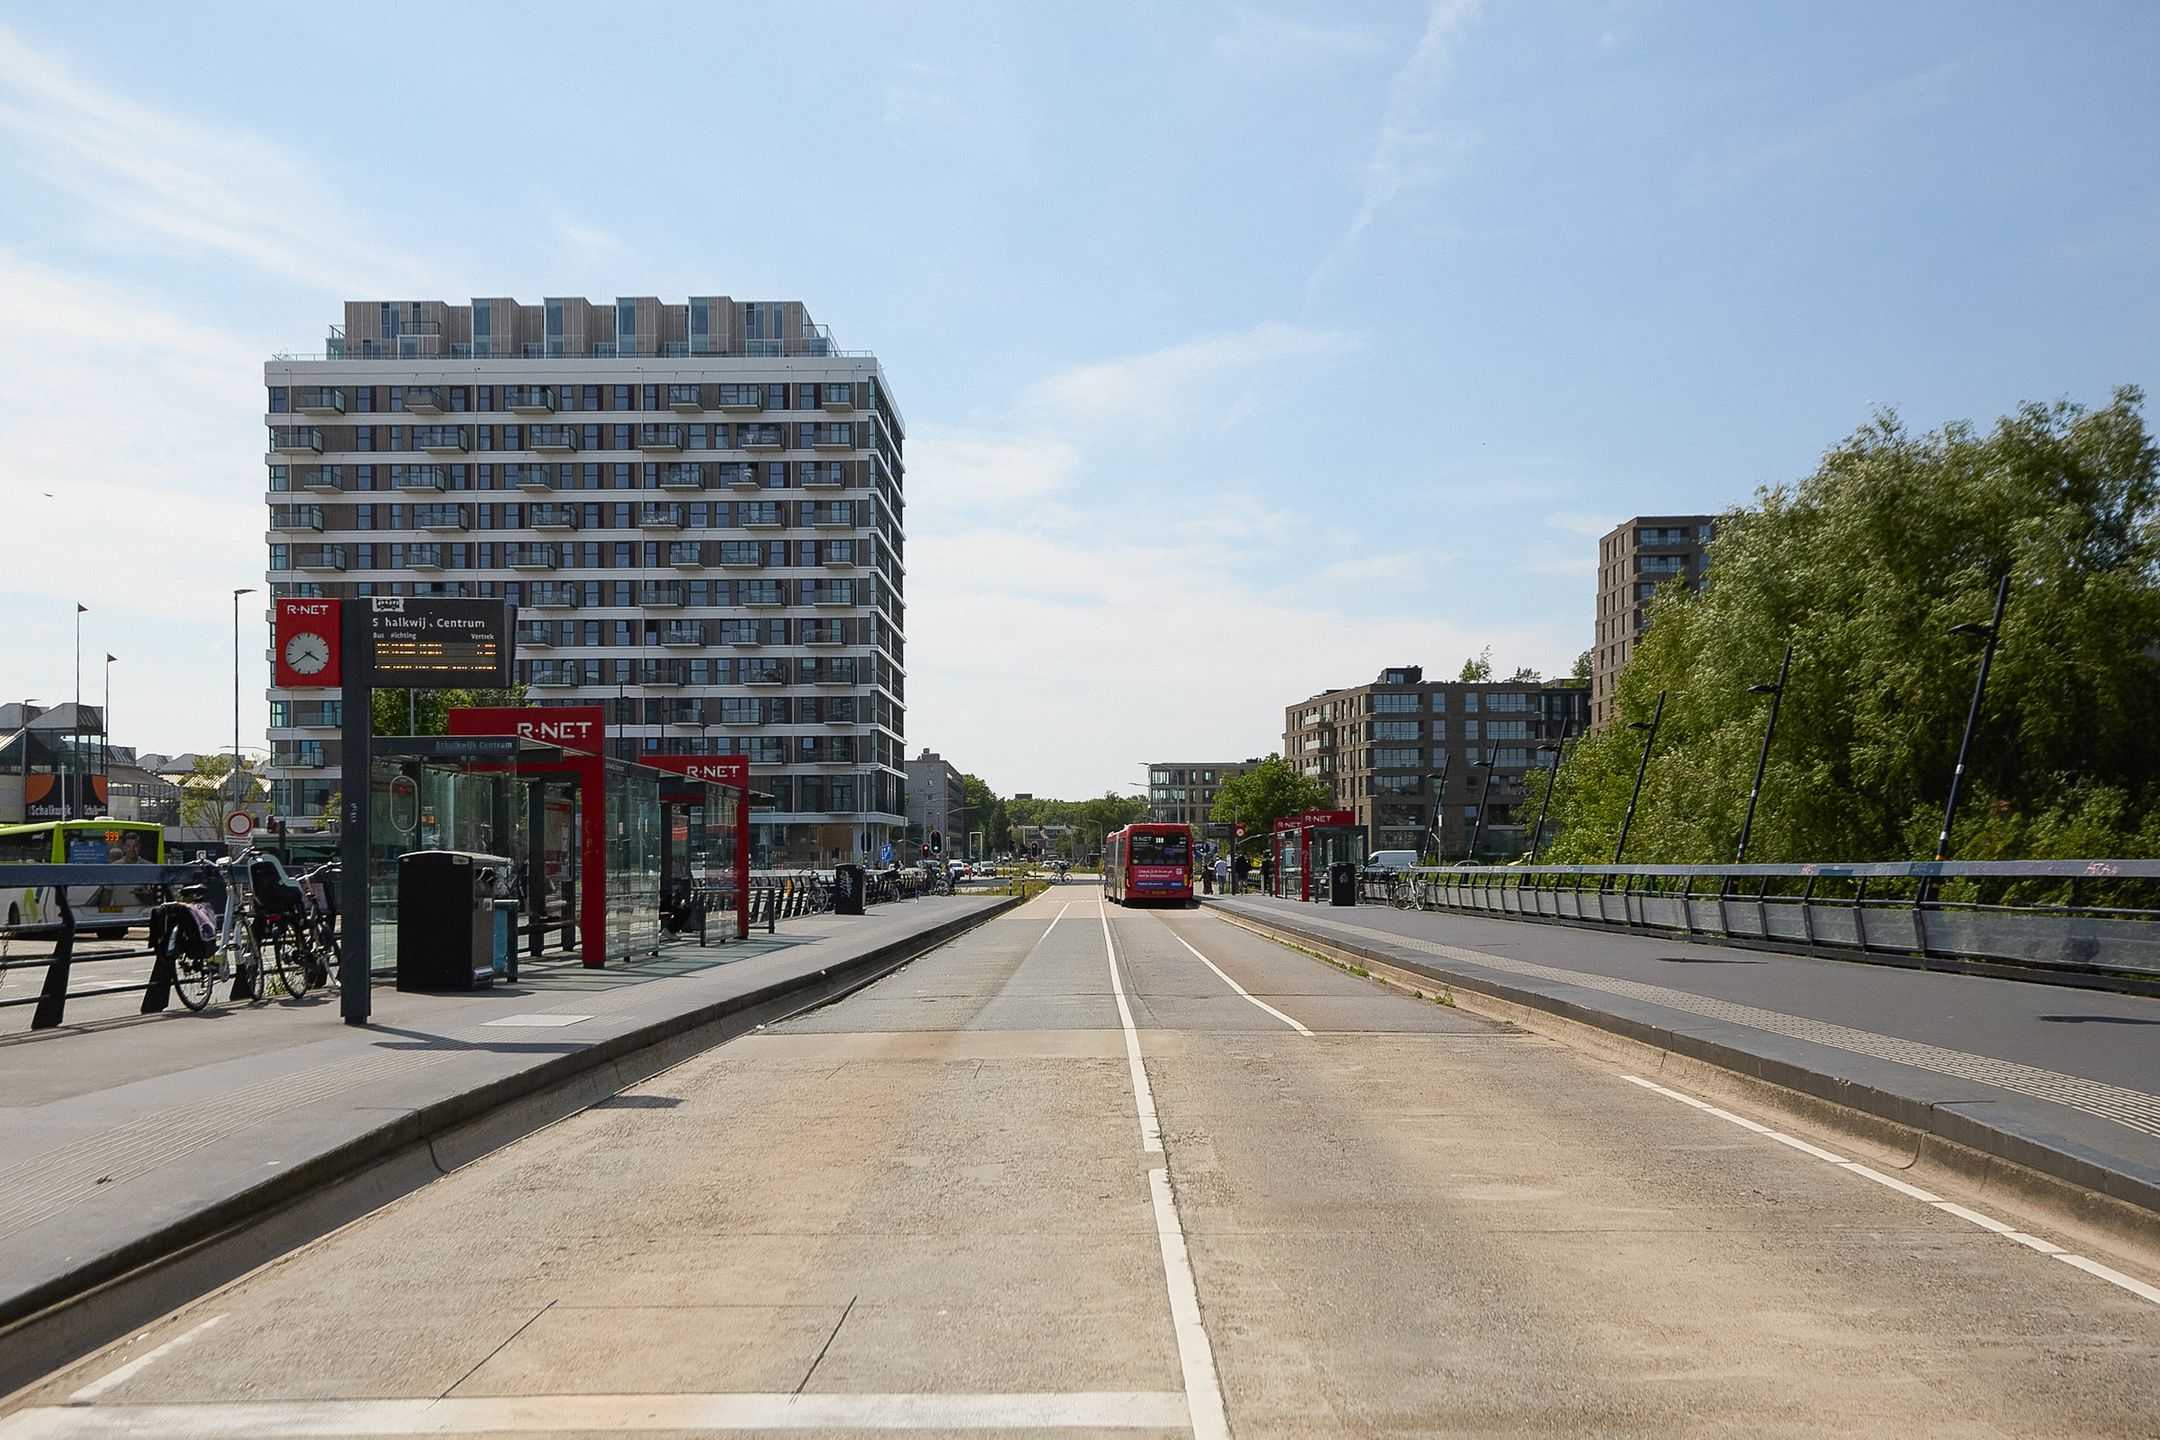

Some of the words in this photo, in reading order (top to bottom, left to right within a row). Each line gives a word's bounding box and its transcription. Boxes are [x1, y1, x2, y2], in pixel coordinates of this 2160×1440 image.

[372, 617, 433, 630] Shalkwij
[436, 618, 485, 629] Centrum
[104, 831, 120, 841] 999
